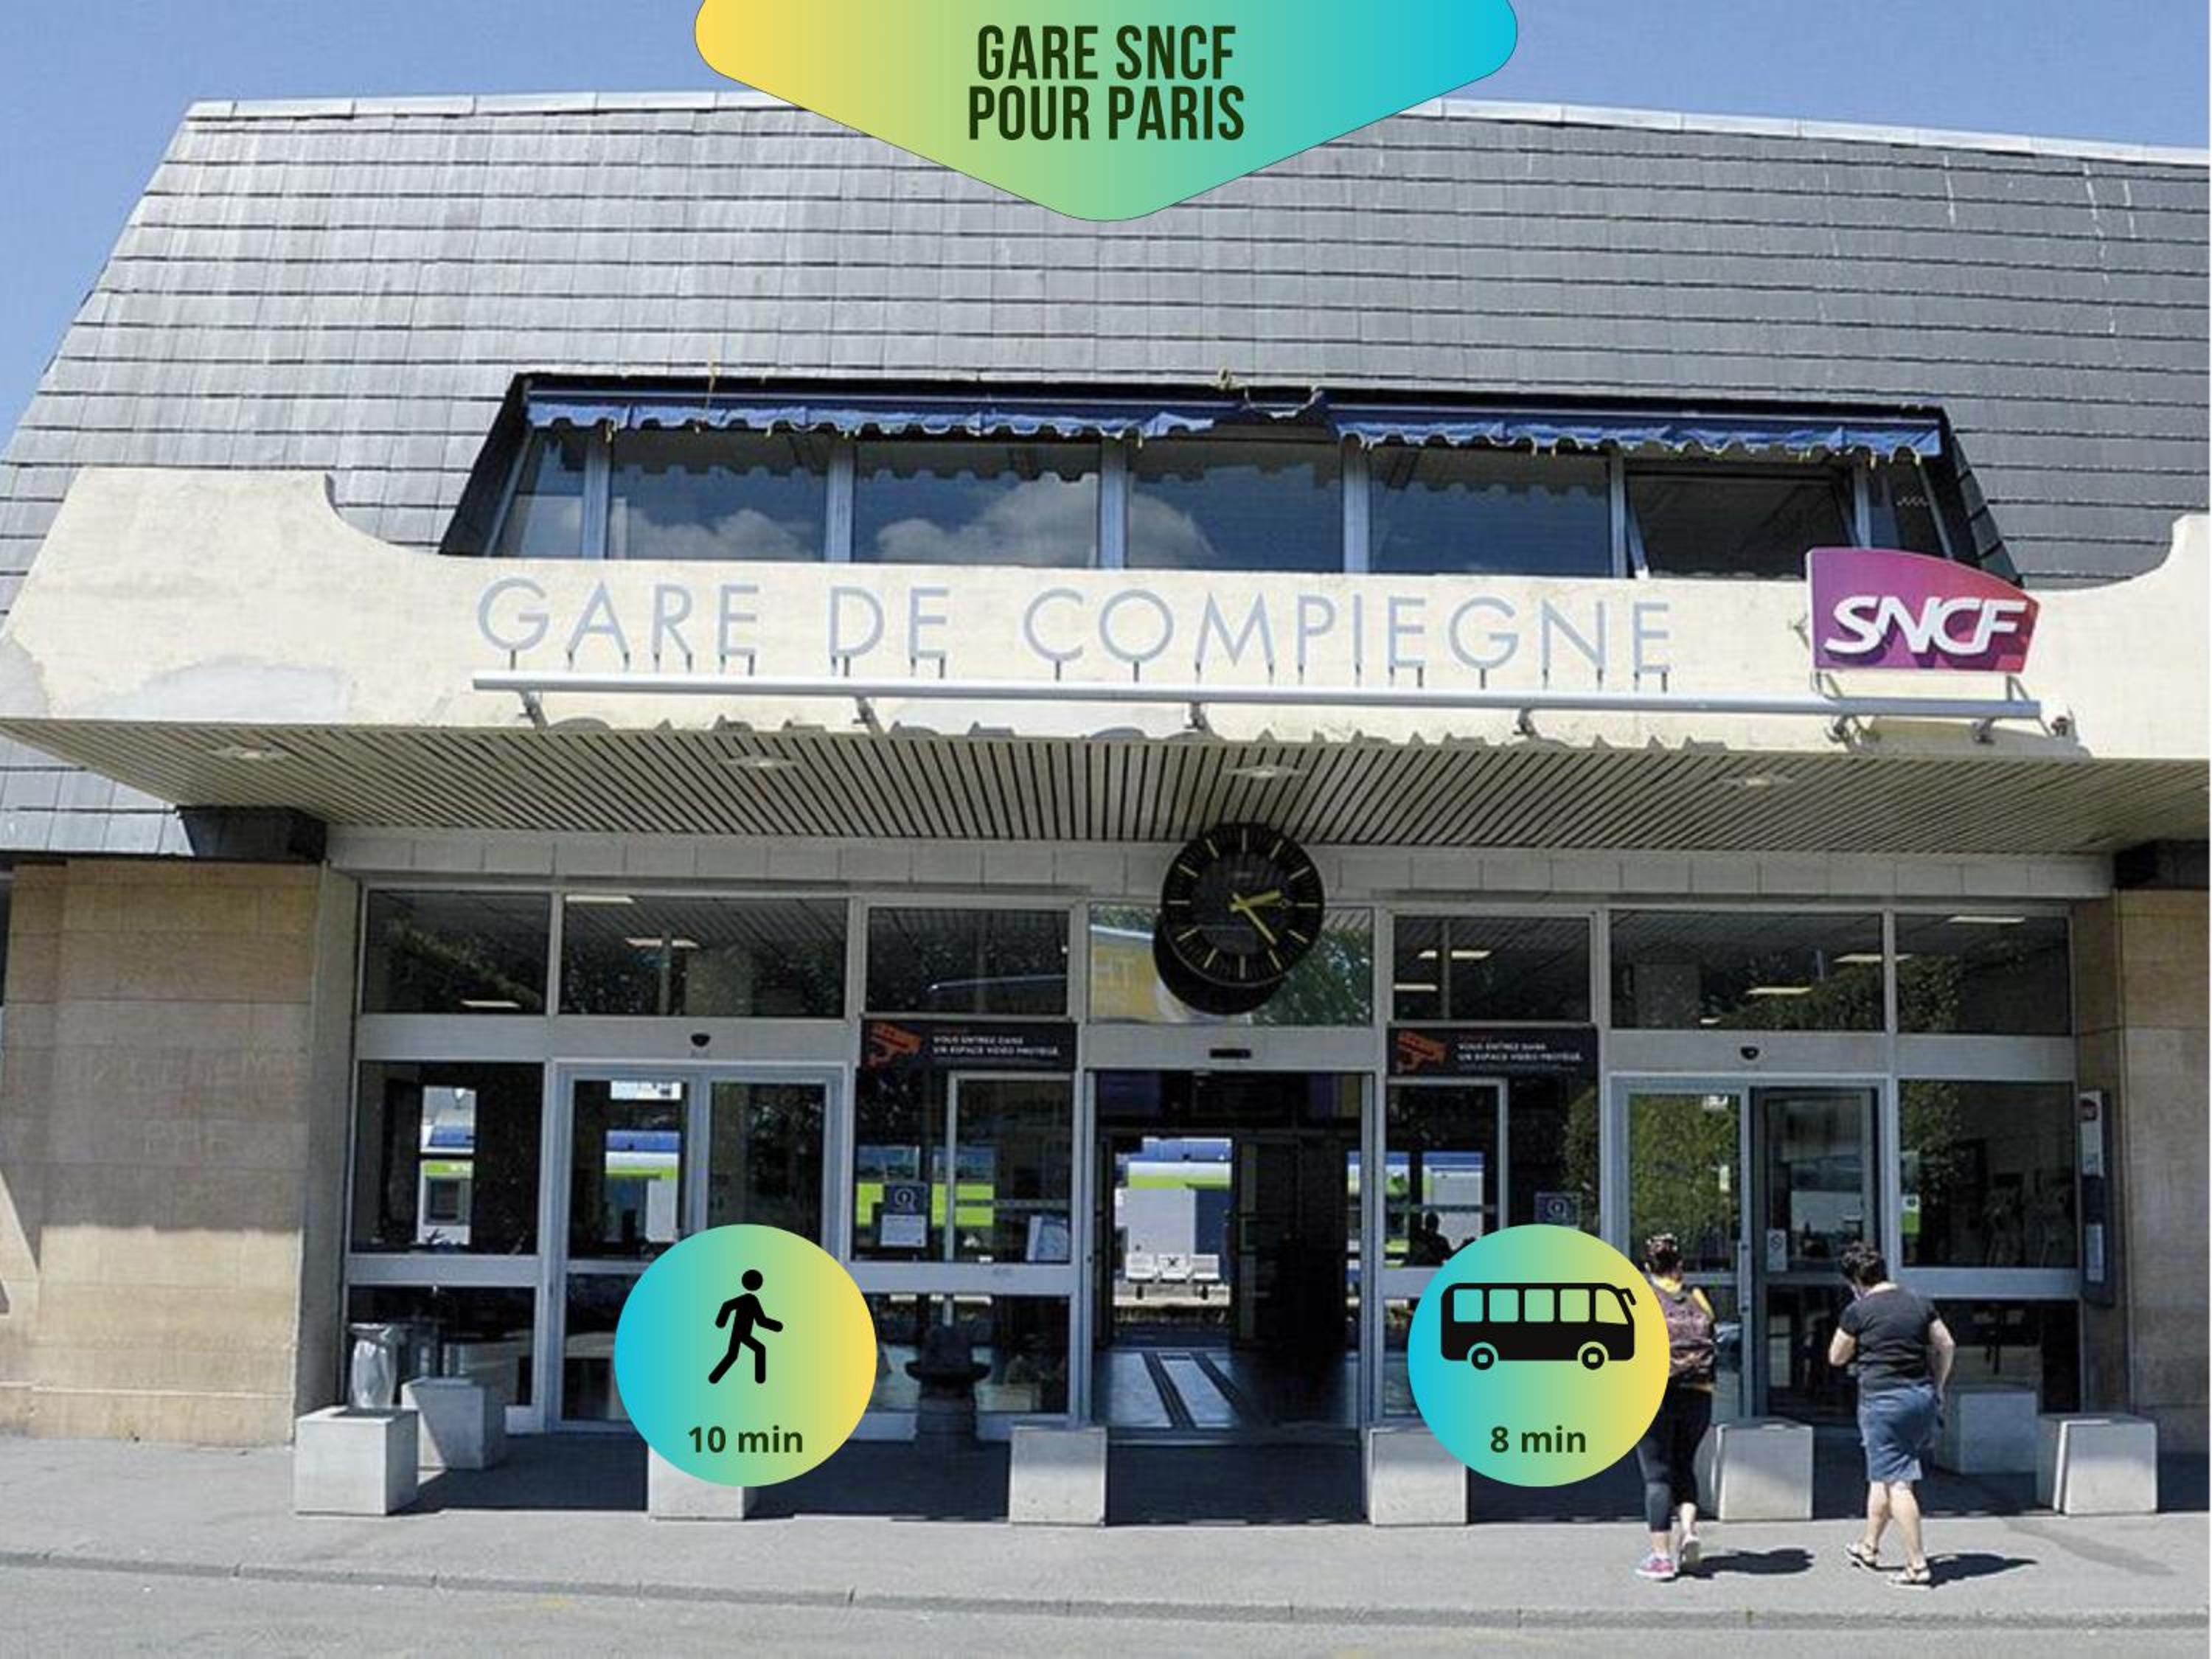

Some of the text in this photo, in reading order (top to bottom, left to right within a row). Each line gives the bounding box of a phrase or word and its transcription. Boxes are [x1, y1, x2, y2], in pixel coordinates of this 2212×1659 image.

[477, 576, 1671, 674] GARE DE COMPIEGNE
[1824, 595, 2026, 655] SNCF
